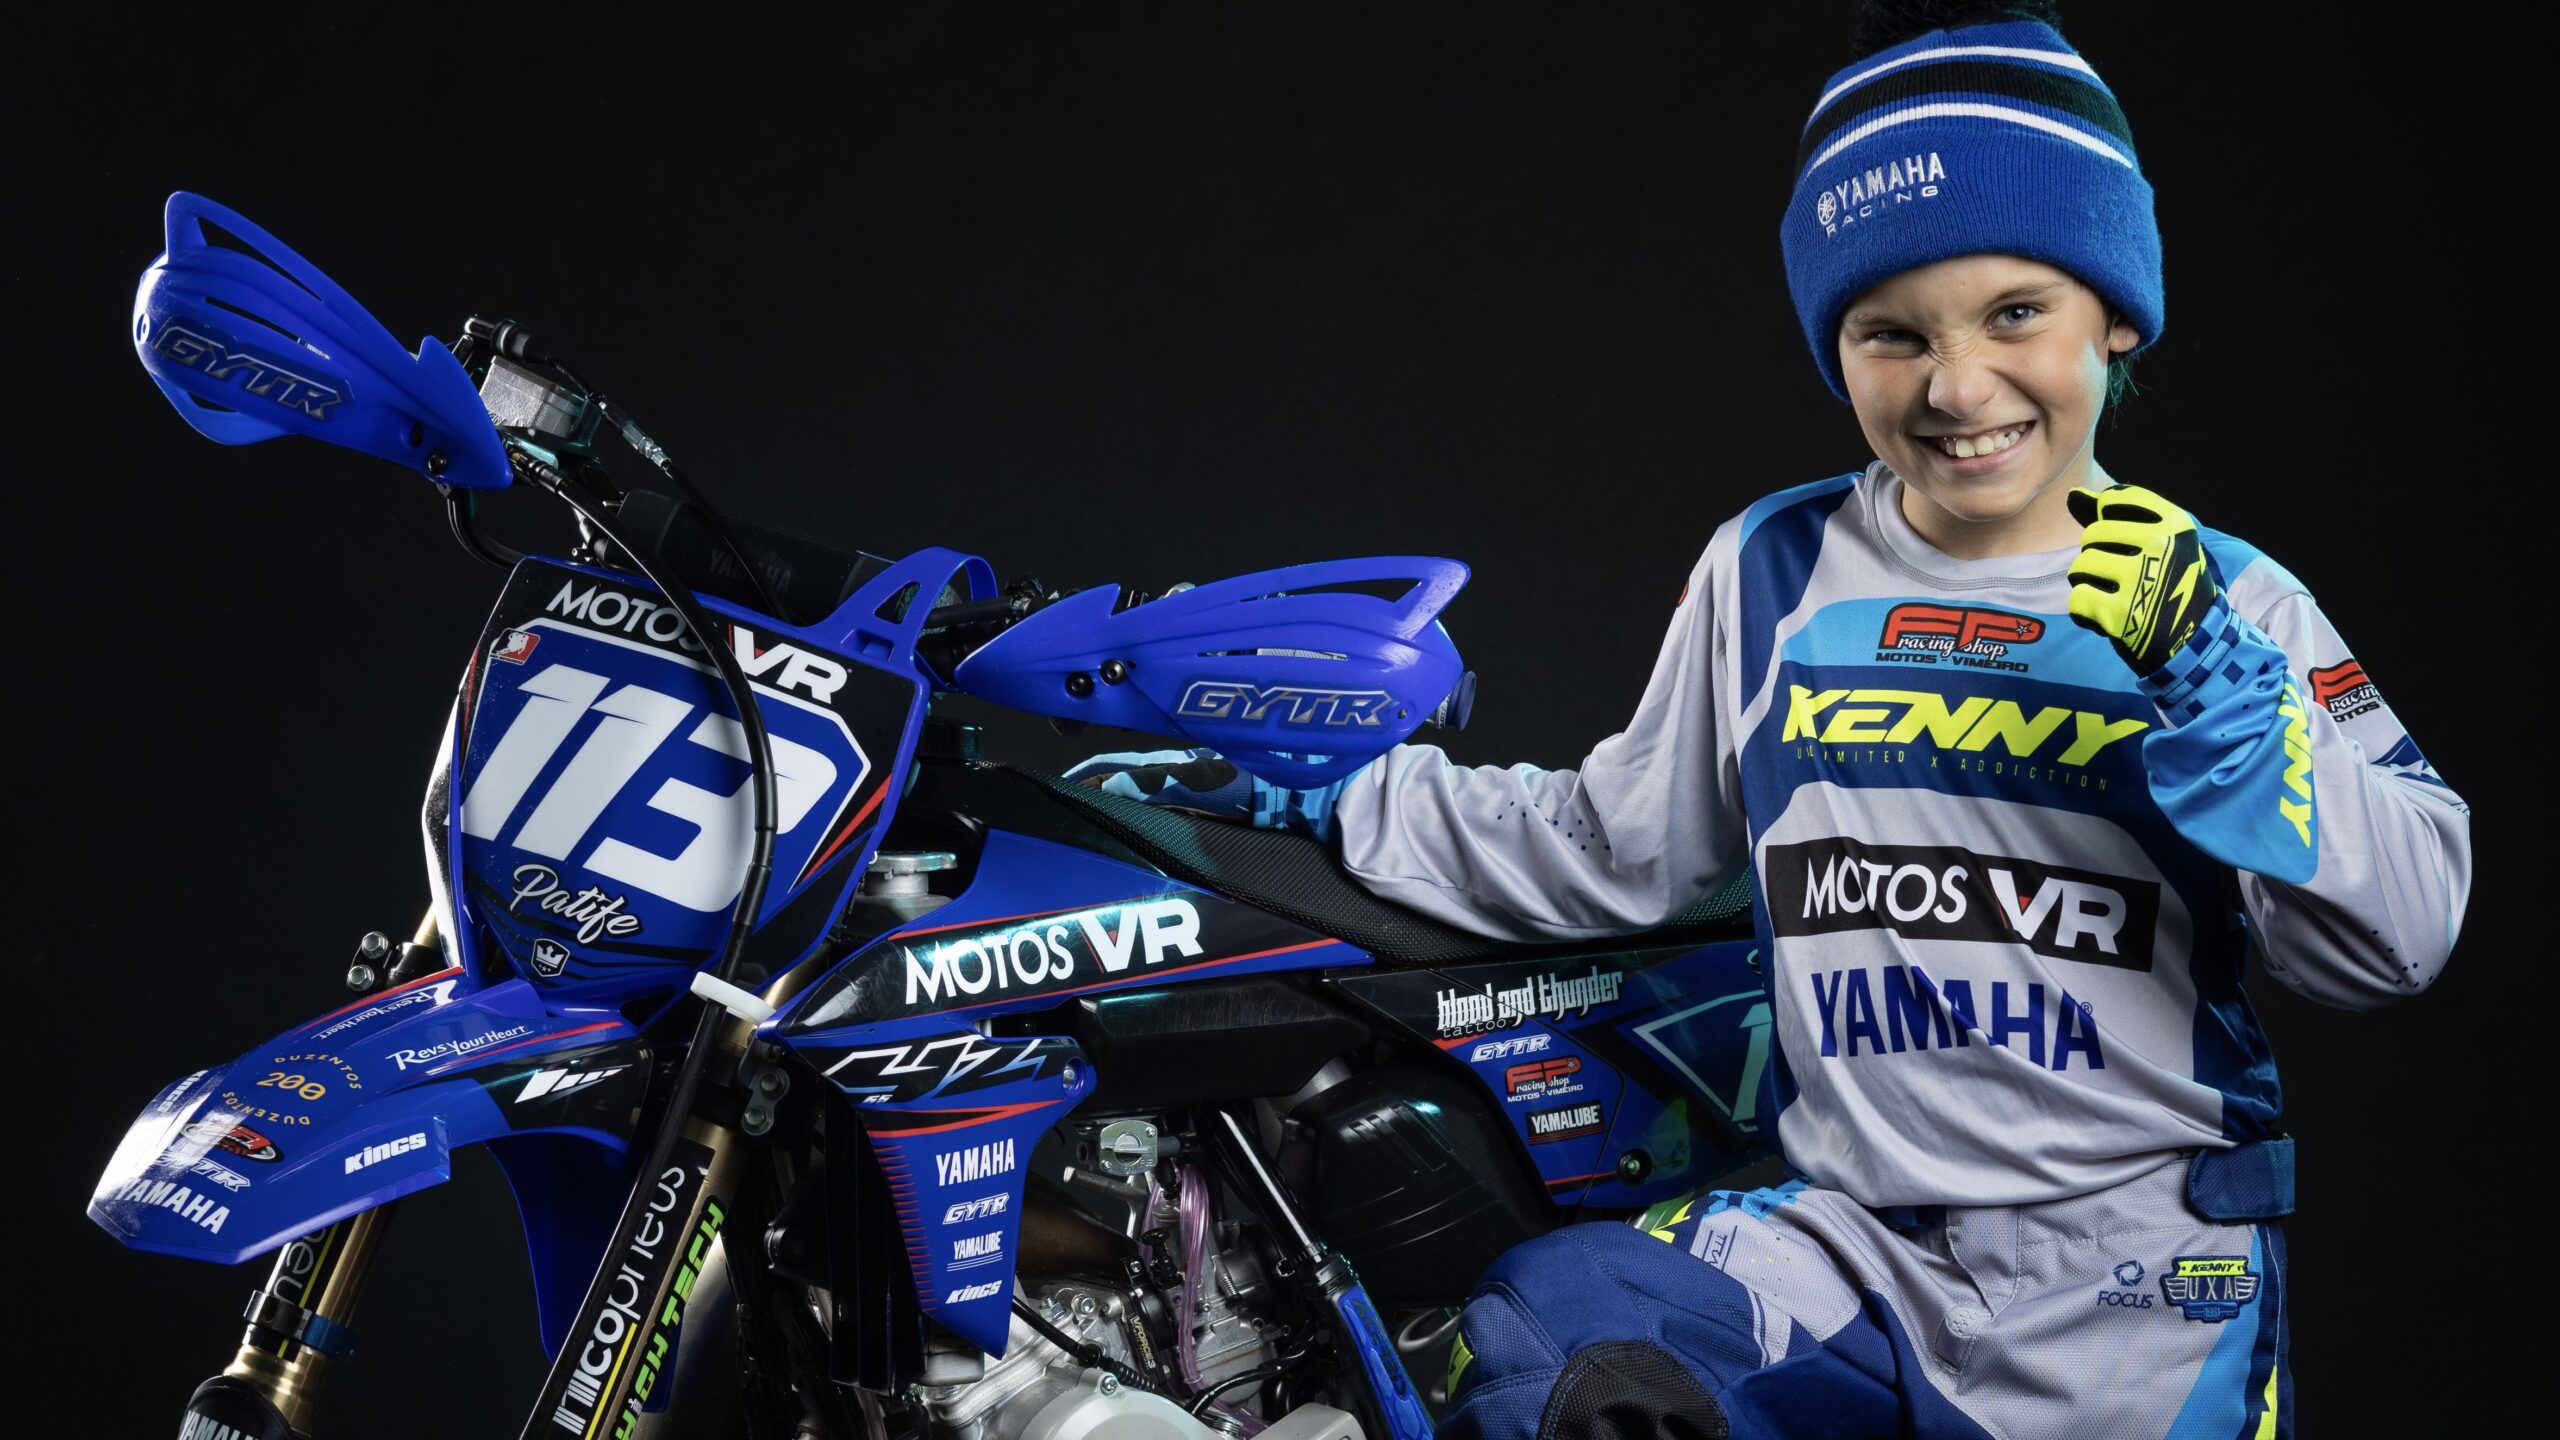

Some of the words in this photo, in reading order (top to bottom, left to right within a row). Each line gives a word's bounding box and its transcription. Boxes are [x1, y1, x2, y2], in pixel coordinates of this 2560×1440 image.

[1836, 152, 1945, 210] YAMAHA
[1826, 185, 1939, 237] RACING
[152, 323, 345, 421] GYTR
[1879, 602, 2045, 651] FP
[733, 625, 849, 704] VR
[1875, 652, 1937, 665] MOTOS
[1952, 655, 2029, 673] VIMEIRO
[1898, 633, 1957, 658] racing
[1961, 638, 2007, 660] shop
[1177, 681, 1392, 726] GYTR
[2333, 701, 2381, 722] OTOS
[1782, 684, 2149, 766] KENNY
[443, 664, 838, 912] 113
[1931, 756, 1938, 768] X
[1961, 758, 2108, 791] ADDICTION
[513, 864, 641, 944] Patife
[1803, 854, 1968, 923] MOTOS
[1987, 868, 2127, 955] VR
[904, 924, 1074, 1005] MOTOS
[1080, 898, 1204, 973] VR
[1497, 976, 1536, 1027] and
[1537, 964, 1623, 1021] thunder
[1443, 1017, 1507, 1038] tattoo
[1470, 1033, 1552, 1063] GYTR
[256, 1072, 326, 1101] 200
[274, 1054, 362, 1090] DUZENTOS
[1505, 1056, 1582, 1094] FP
[1515, 1080, 1547, 1094] racing
[1548, 1075, 1570, 1089] shop
[222, 1091, 311, 1125] DUZENTOS
[1507, 1092, 1540, 1103] MOTOS
[1547, 1084, 1583, 1096] VIMEIRO
[1531, 1104, 1600, 1134] YAMALUBE
[936, 1138, 1015, 1186] YAMAHA
[115, 1178, 230, 1235] YAMAHA
[943, 1192, 1010, 1225] GYTR
[953, 1230, 1003, 1260] YAMALUBE
[661, 1202, 725, 1327] TECH
[2190, 1262, 2234, 1273] KENNY
[2098, 1291, 2153, 1309] FOCUS
